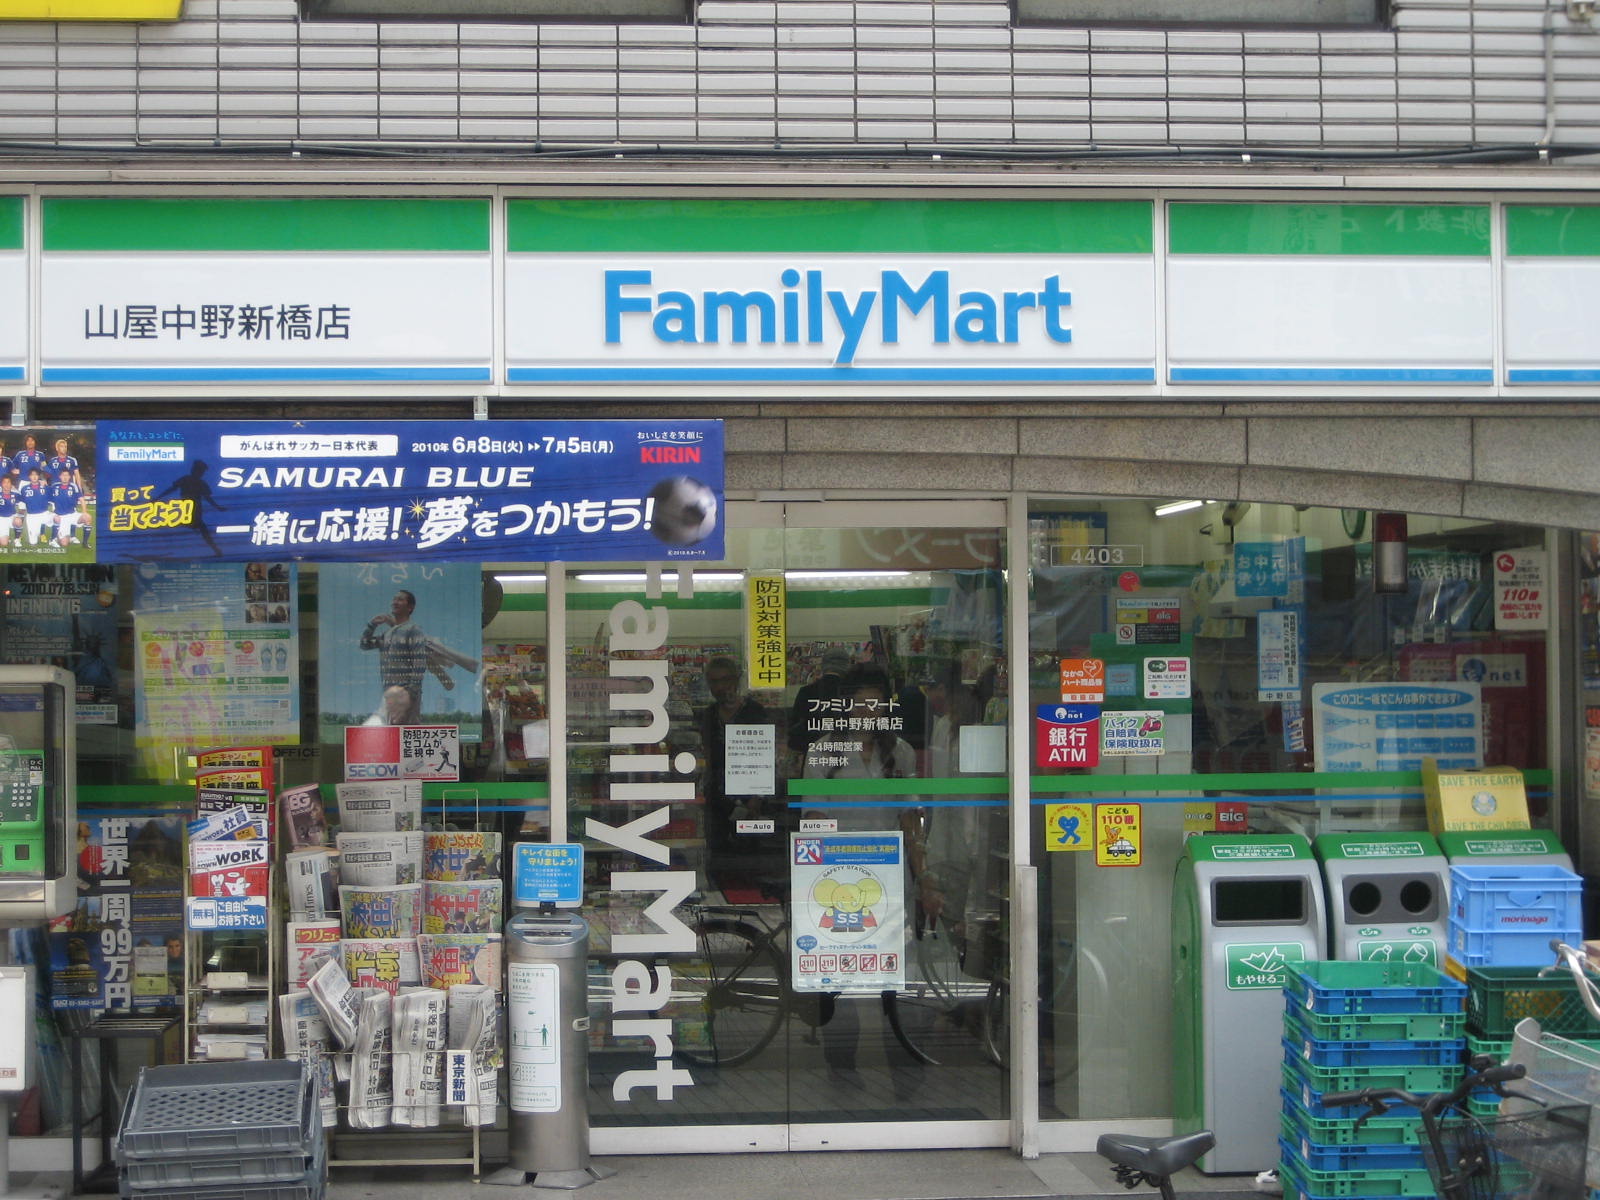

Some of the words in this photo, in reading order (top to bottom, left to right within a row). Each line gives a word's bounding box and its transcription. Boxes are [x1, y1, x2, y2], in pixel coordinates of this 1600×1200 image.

[85, 304, 351, 340] 山屋中野新橋店
[604, 268, 1072, 368] FamilyMart
[637, 431, 704, 440] おいしさを笑顔に
[239, 440, 379, 452] がんばれサッカー日本代表
[116, 448, 178, 461] FamilyMart
[640, 446, 701, 464] KIRIN
[217, 467, 406, 488] SAMURAI
[426, 466, 535, 488] BLUE
[110, 485, 156, 502] 買って
[1071, 548, 1124, 564] 4403
[1238, 554, 1286, 566] お中元
[755, 579, 783, 684] 防犯対策強化中
[807, 698, 900, 713] ファミリーマート
[807, 716, 904, 731] 山屋中野新橋店
[1105, 718, 1138, 729] バイク
[403, 729, 457, 740] 防犯カメラで
[1048, 727, 1088, 747] 銀行
[1105, 728, 1138, 739] 自賠責
[403, 739, 442, 749] セコムが
[808, 741, 864, 752] 24時間営業
[1105, 739, 1162, 749] 保険取扱店
[402, 748, 435, 758] 監視中
[1048, 748, 1087, 762] ATM
[807, 756, 849, 767] 年中無休
[348, 764, 398, 777] SECOM
[1440, 776, 1465, 786] SAVE
[1468, 775, 1487, 786] THE
[1490, 775, 1524, 786] EARTH
[1107, 807, 1130, 815] こども
[753, 822, 772, 830] Auto
[803, 821, 821, 829] Auto
[216, 847, 265, 866] WORK
[216, 901, 248, 913] ご自由に
[192, 907, 216, 921] 無料
[836, 913, 859, 923] SS
[1501, 914, 1549, 924] morinaga
[217, 914, 265, 927] お持ち下さい
[452, 1054, 466, 1102] 東京新聞
